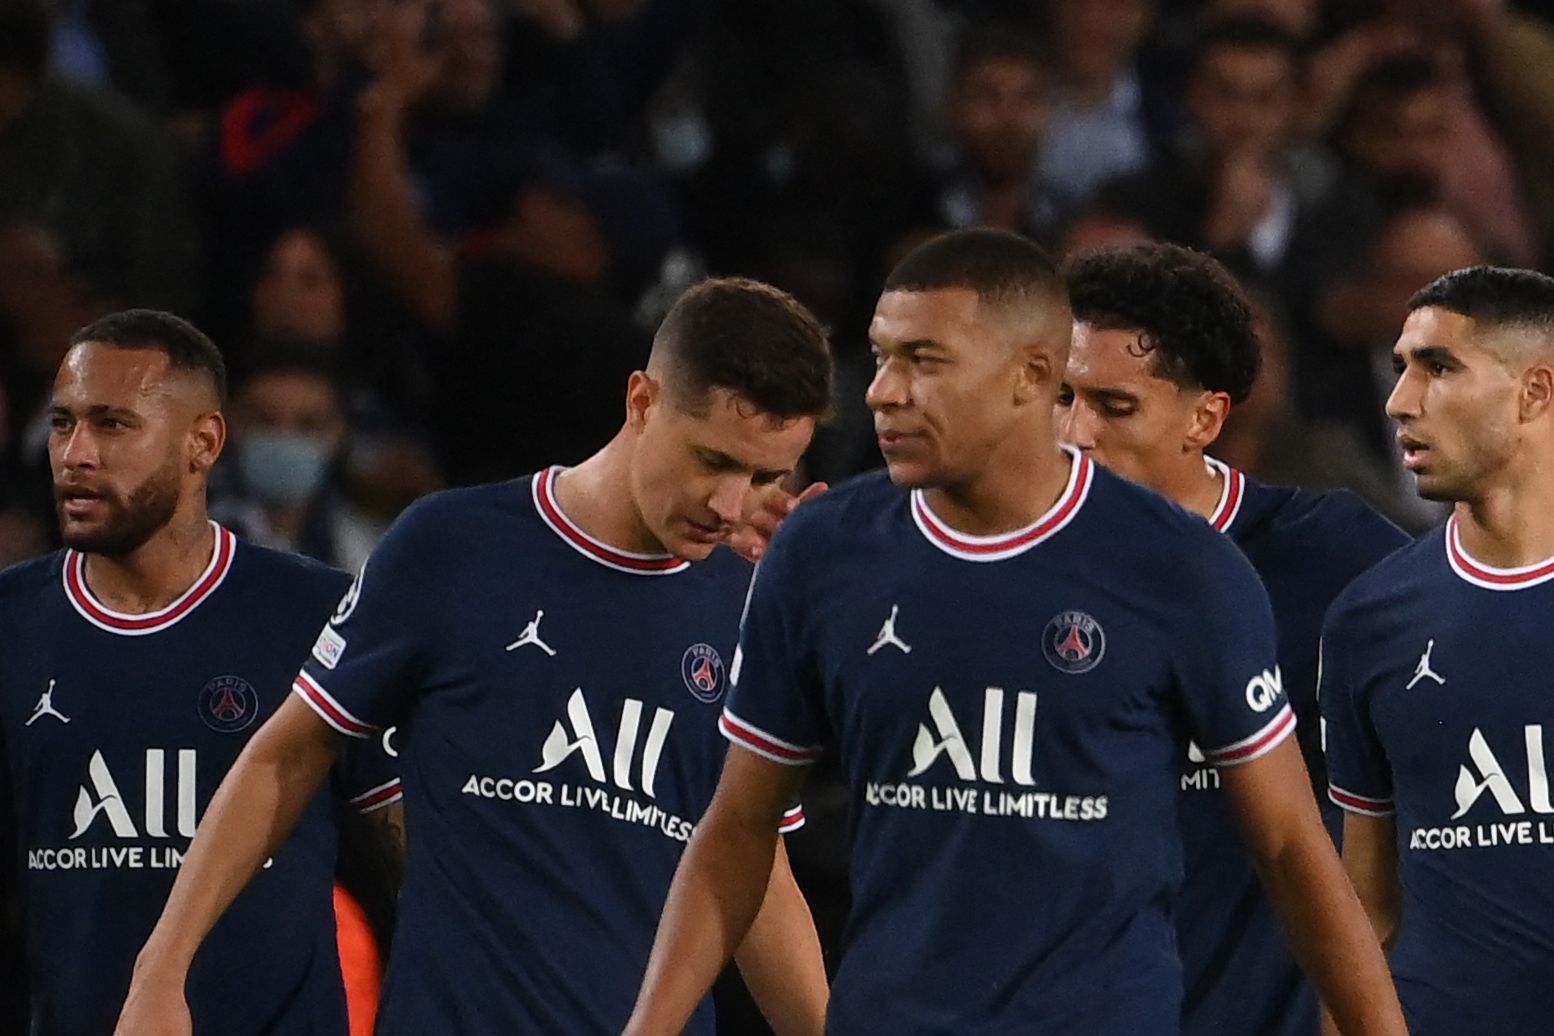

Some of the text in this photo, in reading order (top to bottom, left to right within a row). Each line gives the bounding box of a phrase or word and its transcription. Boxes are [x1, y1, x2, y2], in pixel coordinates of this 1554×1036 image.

[462, 774, 553, 805] ACCOR
[561, 784, 611, 812] LIVE
[931, 786, 978, 813] LIVE
[983, 792, 1109, 820] LIMITLESS
[1410, 828, 1472, 849] ACCOR
[1477, 822, 1532, 847] LIVE
[28, 849, 87, 870] ACCOR
[92, 847, 143, 868] LIVE
